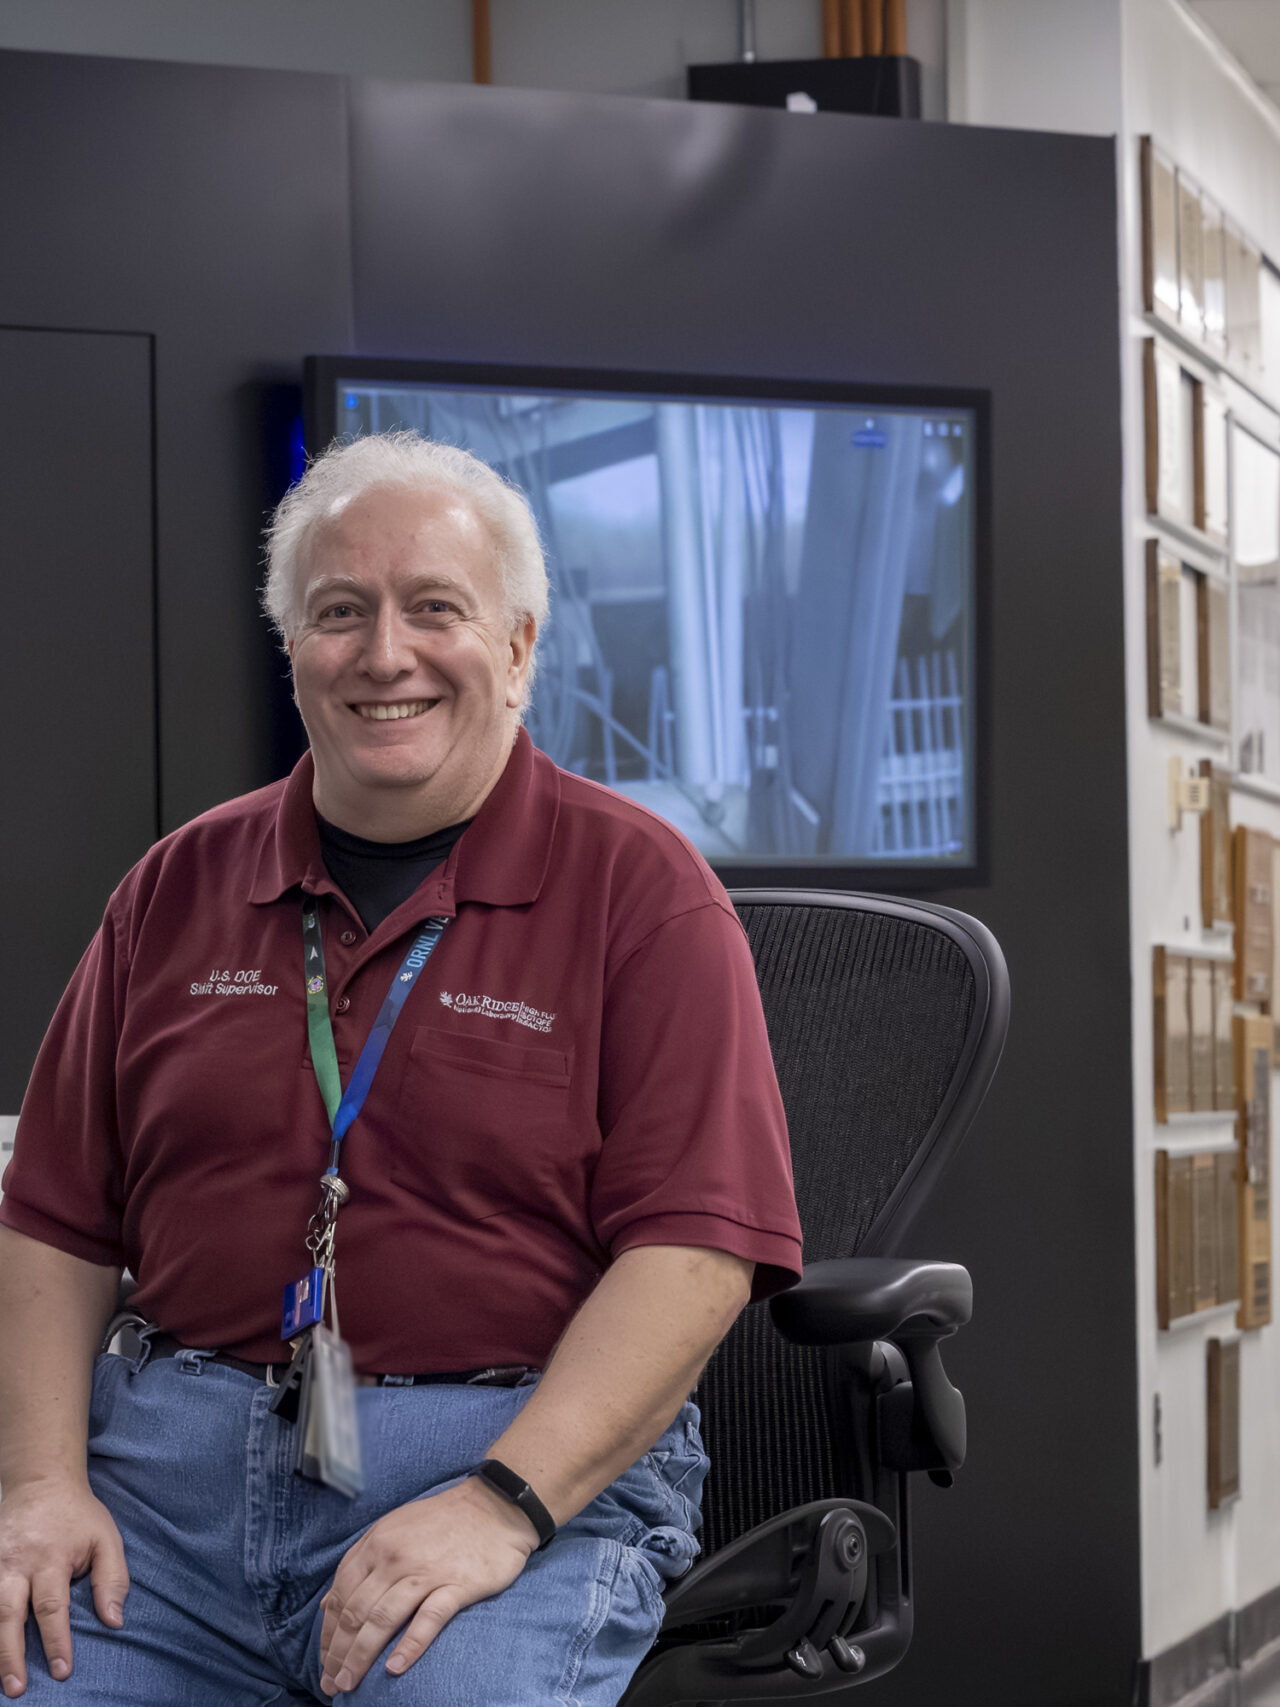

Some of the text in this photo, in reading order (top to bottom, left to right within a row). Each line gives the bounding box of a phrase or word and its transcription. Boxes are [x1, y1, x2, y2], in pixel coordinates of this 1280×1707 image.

[406, 934, 440, 968] ORNL
[209, 969, 262, 983] U.S. DOE
[190, 982, 279, 996] Shift Supervisor
[455, 993, 520, 1012] OAK RIDGE
